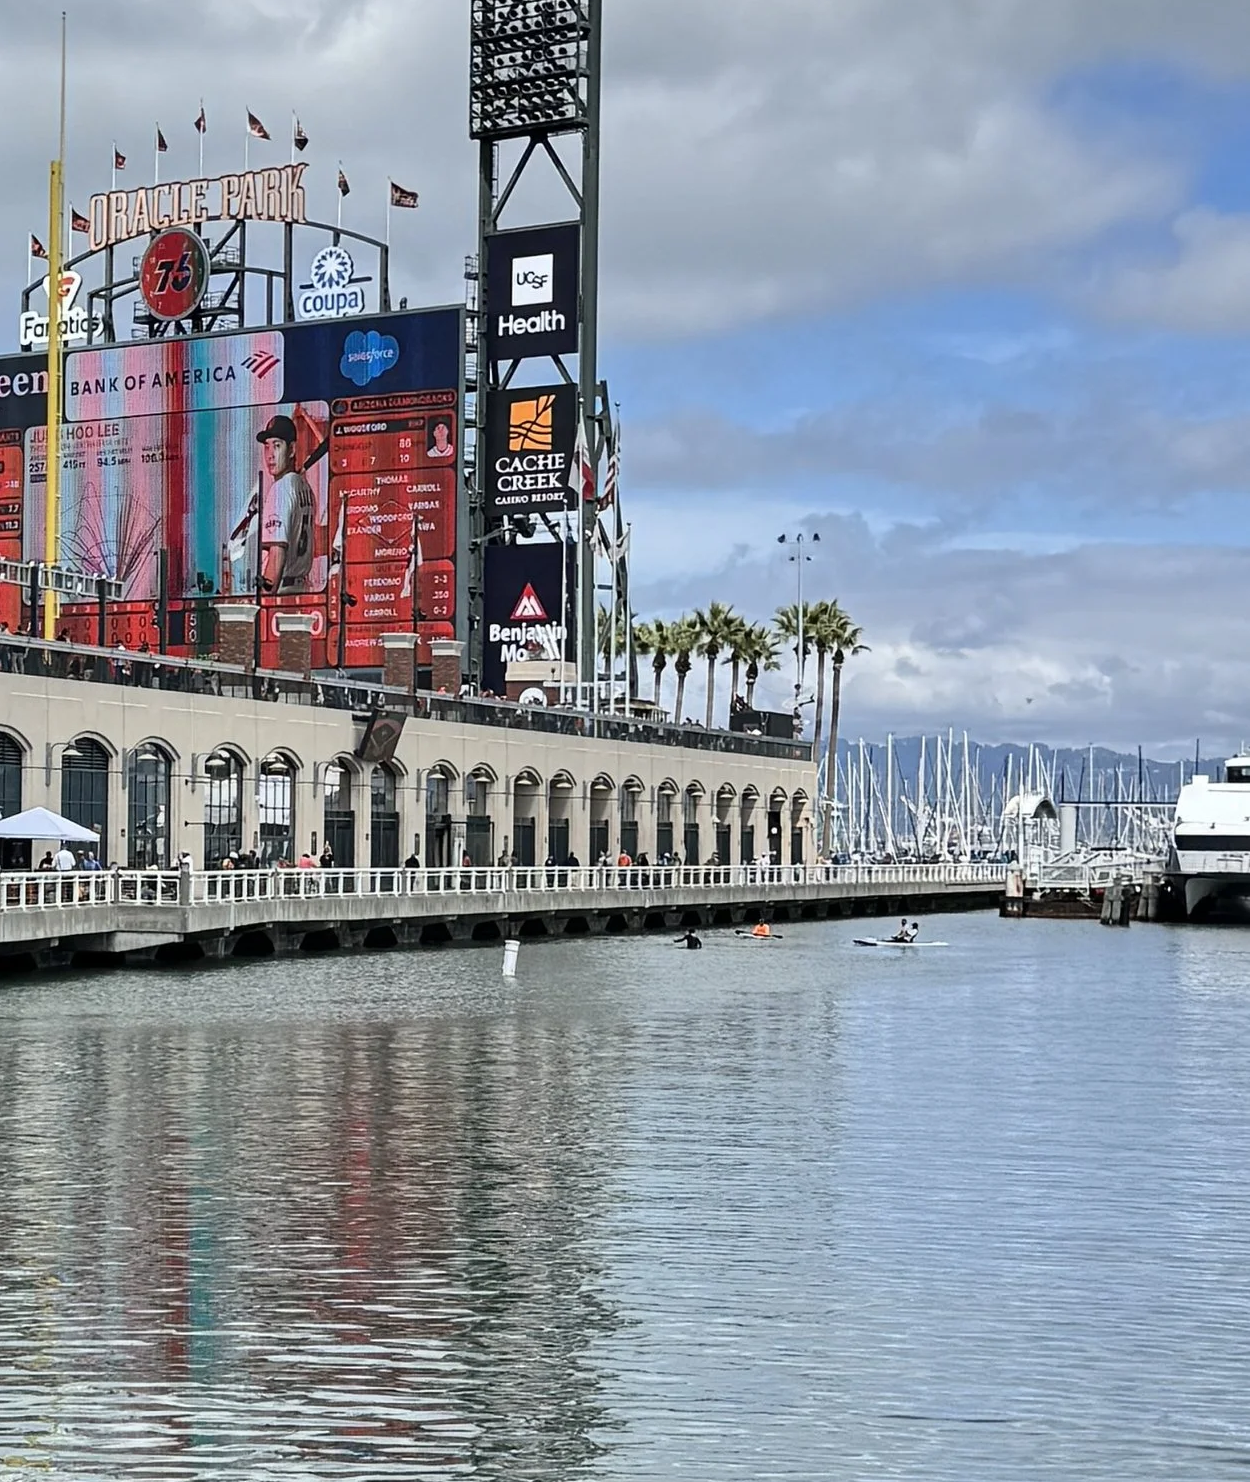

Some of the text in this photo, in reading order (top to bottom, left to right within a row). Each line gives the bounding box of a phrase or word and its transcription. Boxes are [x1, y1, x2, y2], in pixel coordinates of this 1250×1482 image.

[88, 162, 310, 252] ORACLE PARK
[154, 251, 193, 296] 76
[516, 271, 548, 289] UCSF
[302, 295, 359, 317] coupa
[25, 315, 100, 340] Faatics
[498, 309, 565, 336] Health
[348, 348, 395, 364] salesforce
[70, 365, 237, 397] BANK OF AMERICA
[97, 423, 120, 438] LEE
[495, 453, 565, 474] CACHE
[497, 472, 563, 492] CREEK
